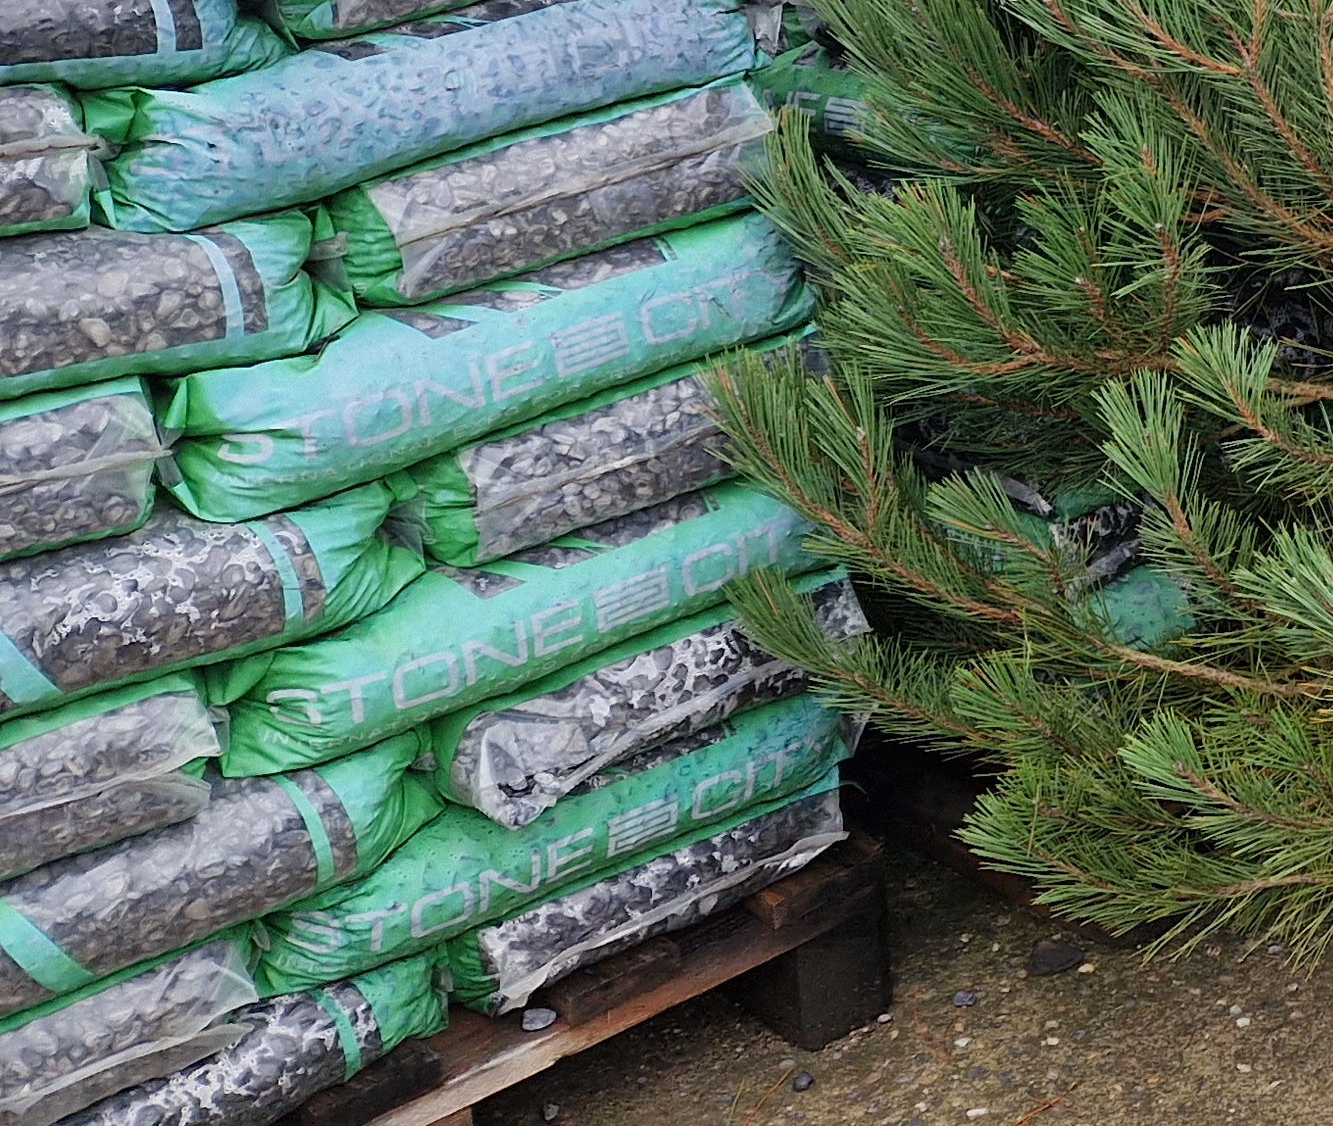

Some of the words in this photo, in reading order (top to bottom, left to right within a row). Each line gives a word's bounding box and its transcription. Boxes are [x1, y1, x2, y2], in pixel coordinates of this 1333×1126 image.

[216, 340, 542, 466] STONE
[266, 601, 584, 727] STONE
[681, 517, 794, 597] CIT
[291, 828, 595, 954] STONE
